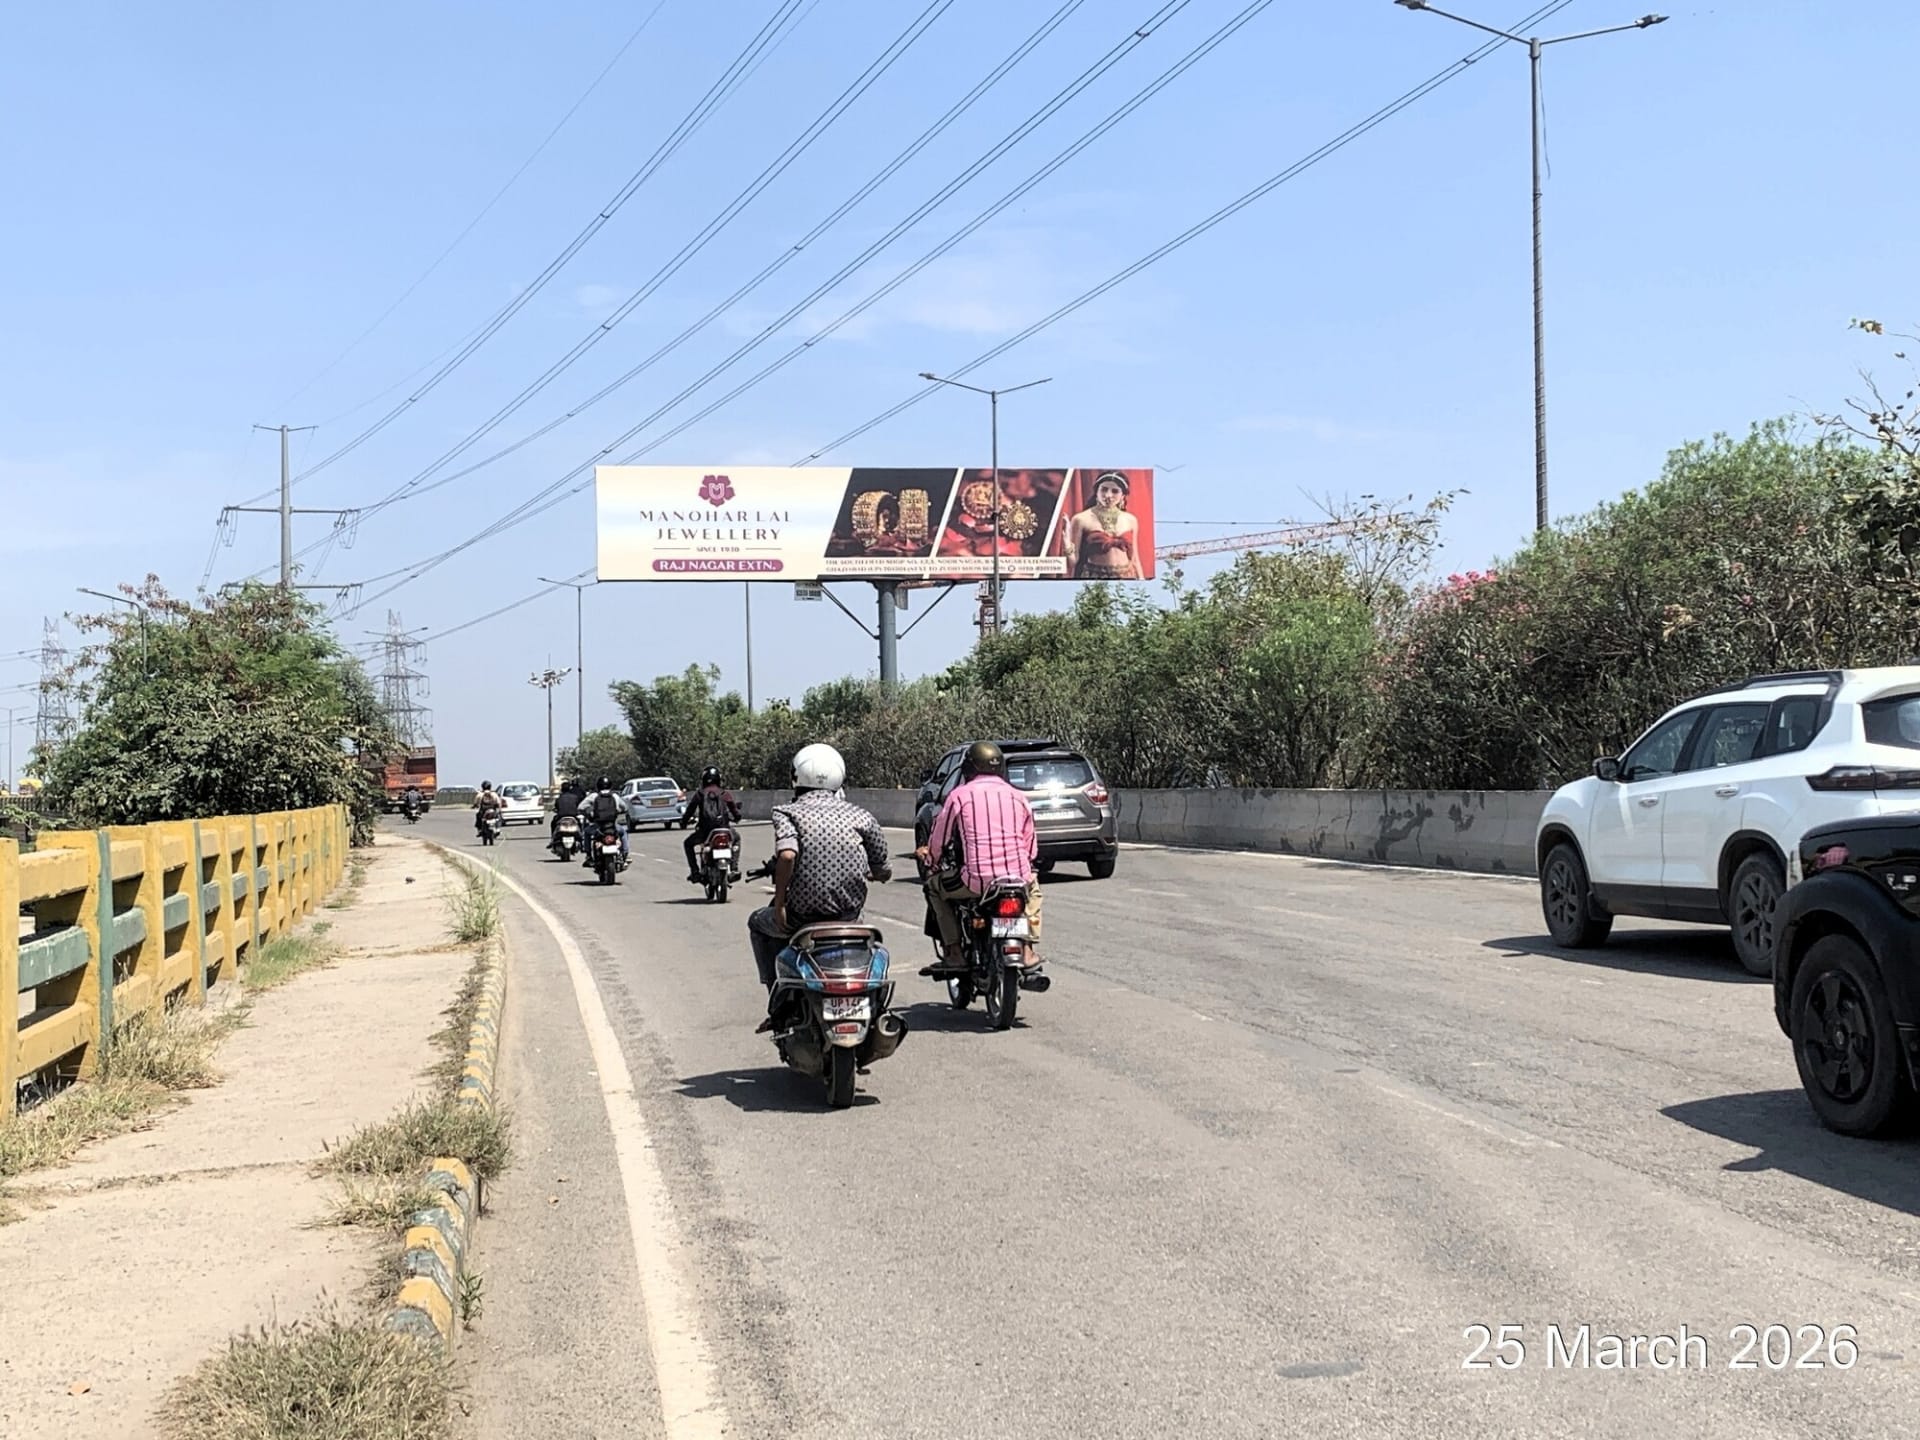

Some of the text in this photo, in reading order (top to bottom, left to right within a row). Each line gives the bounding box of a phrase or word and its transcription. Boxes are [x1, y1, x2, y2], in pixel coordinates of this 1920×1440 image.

[640, 510, 792, 522] MANOHAR LAL
[657, 528, 781, 540] JEWELLERY
[659, 560, 776, 571] RAJ NAGAR EXTN.
